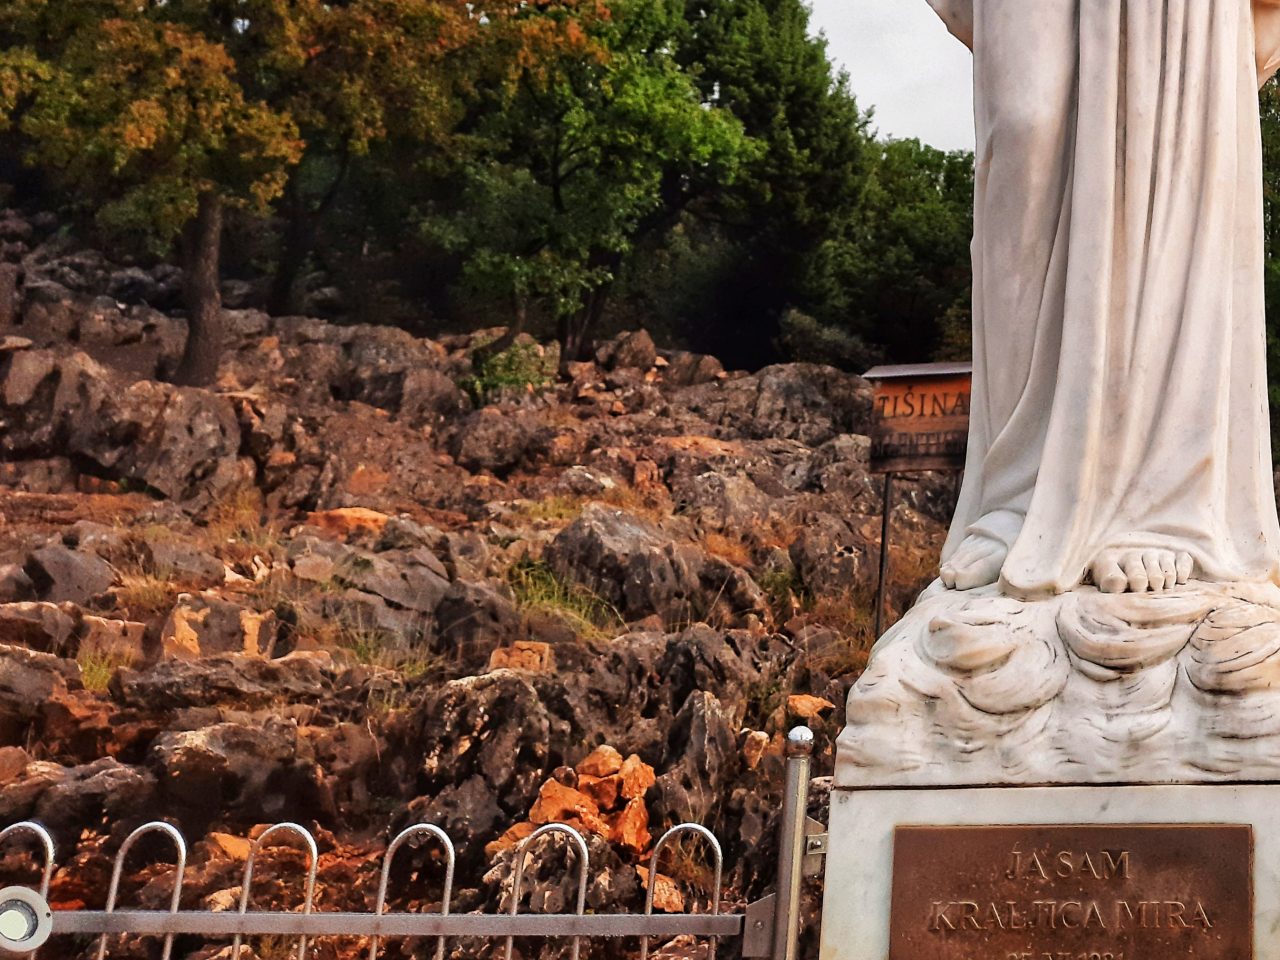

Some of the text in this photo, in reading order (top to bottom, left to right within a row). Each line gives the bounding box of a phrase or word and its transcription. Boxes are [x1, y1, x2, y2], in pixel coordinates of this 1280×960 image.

[878, 386, 970, 419] TIŠINA
[1005, 850, 1131, 880] JA SAM
[930, 900, 1214, 930] KRALJICA MIRA
